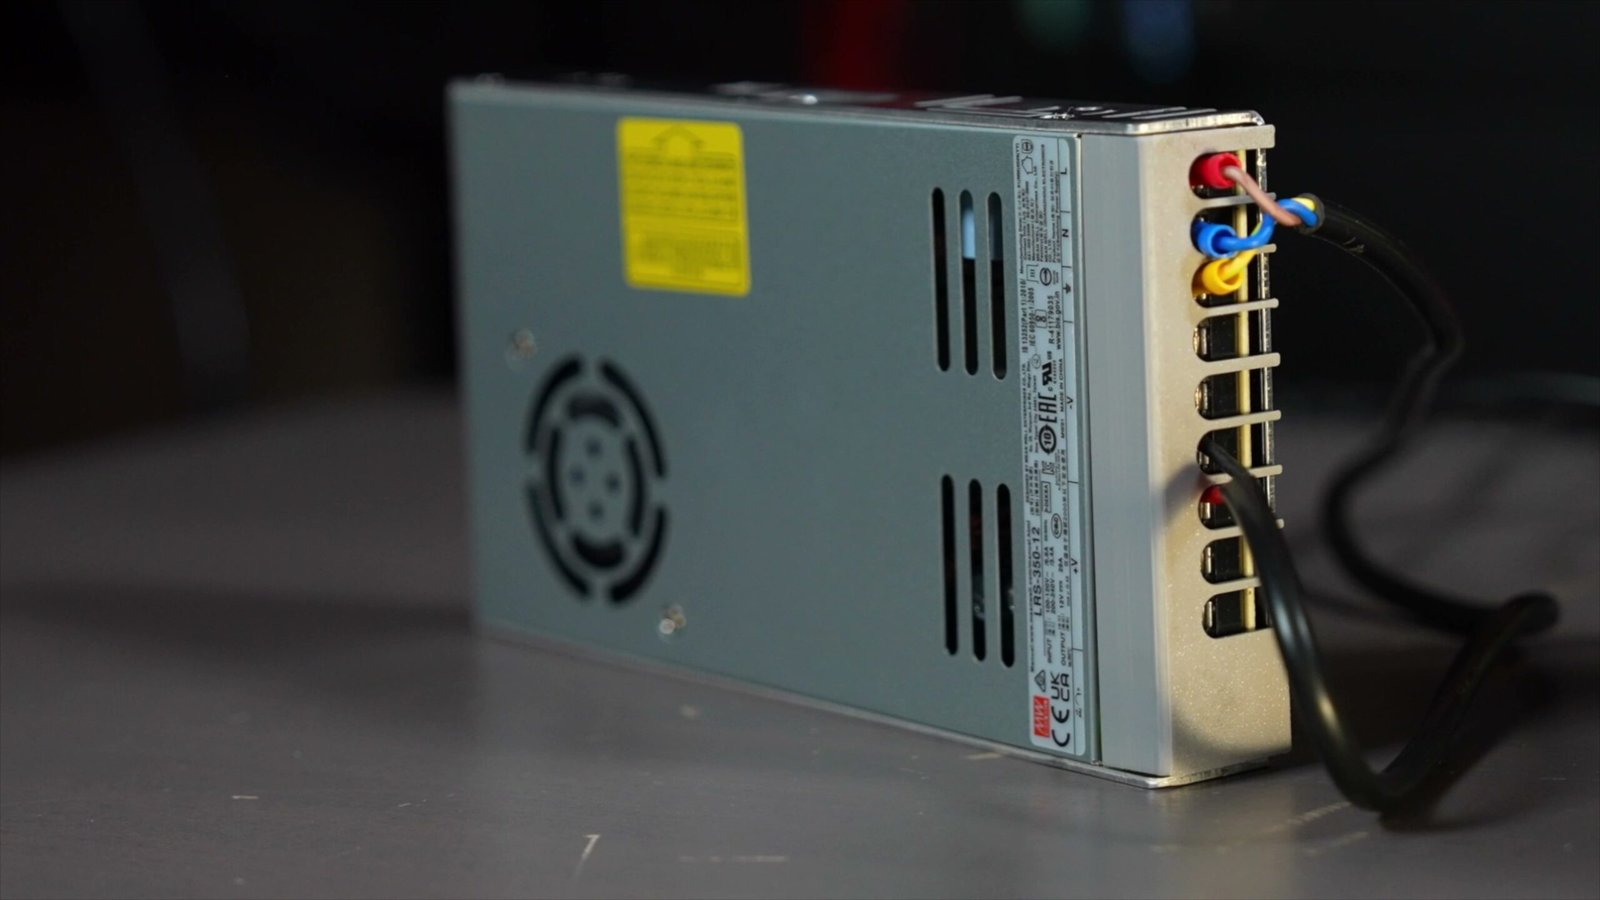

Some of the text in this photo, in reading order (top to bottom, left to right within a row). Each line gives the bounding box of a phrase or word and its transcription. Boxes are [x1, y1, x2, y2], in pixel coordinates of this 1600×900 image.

[1062, 228, 1069, 238] N
[1054, 290, 1062, 350] www.bis.gov.in
[1038, 392, 1058, 423] EAC
[1044, 433, 1052, 446] 10
[1031, 526, 1043, 617] LRS-350-12
[1050, 672, 1060, 700] UK
[1060, 673, 1070, 702] CA
[1051, 706, 1071, 747] CE
